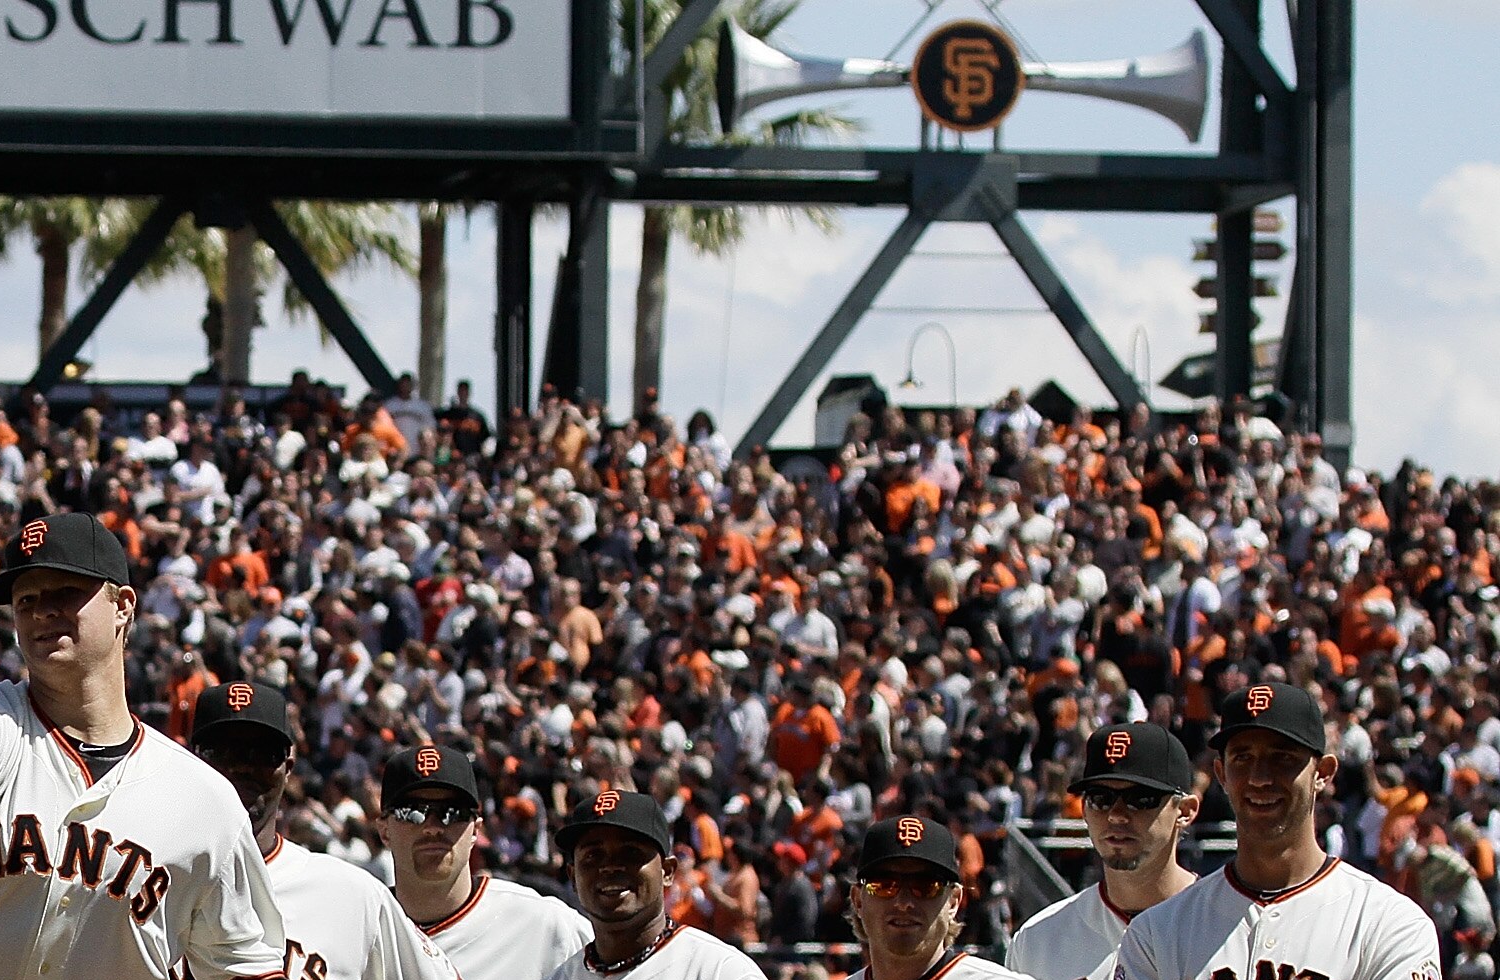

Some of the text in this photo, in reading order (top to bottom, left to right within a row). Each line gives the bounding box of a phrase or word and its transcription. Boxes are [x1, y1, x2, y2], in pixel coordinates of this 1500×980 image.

[3, 0, 516, 48] SCHWAB
[20, 519, 49, 556] SF
[226, 682, 255, 713] SF
[1247, 685, 1273, 716] SF
[415, 747, 442, 777] SF
[1105, 730, 1132, 764] SF
[594, 789, 621, 816] SF
[897, 816, 924, 847] SF
